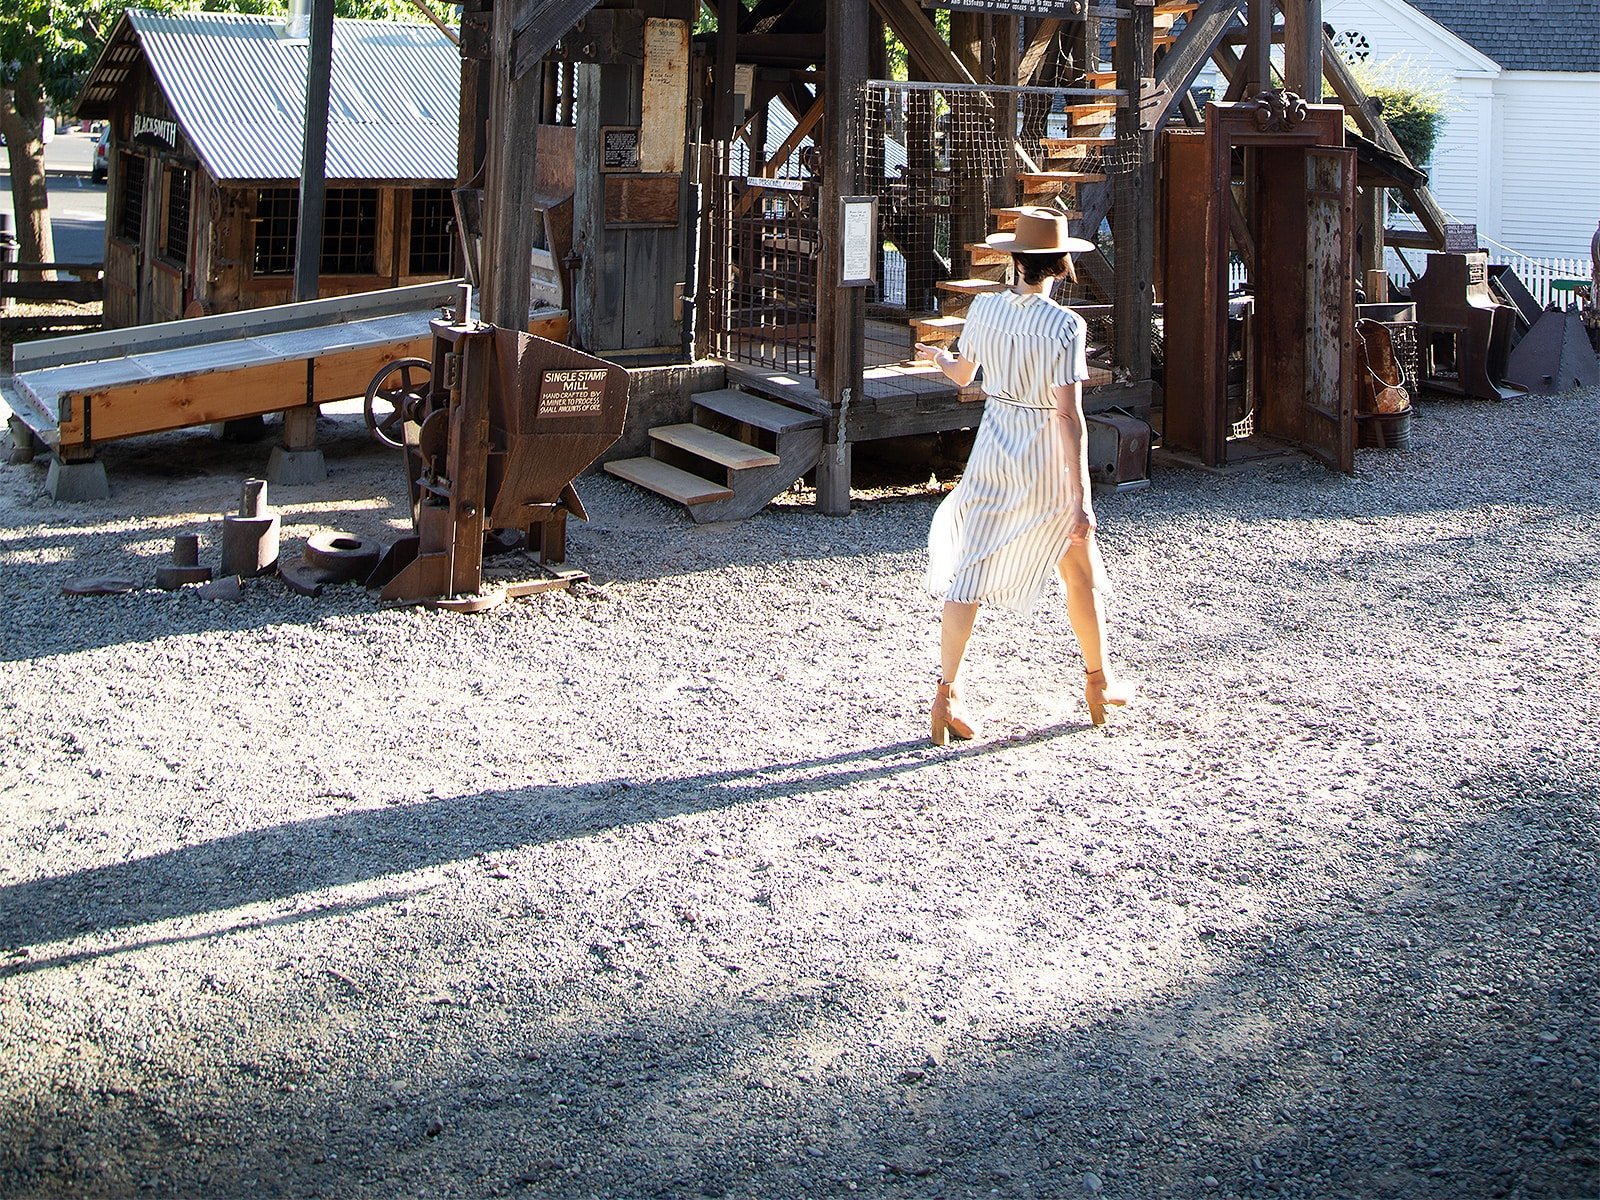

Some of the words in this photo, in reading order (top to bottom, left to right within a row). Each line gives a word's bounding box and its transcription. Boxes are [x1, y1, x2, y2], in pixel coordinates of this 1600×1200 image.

[134, 114, 176, 148] BLACKSMITH
[545, 372, 576, 382] SINGLE
[578, 372, 607, 381] STAMP
[563, 382, 588, 390] MILL
